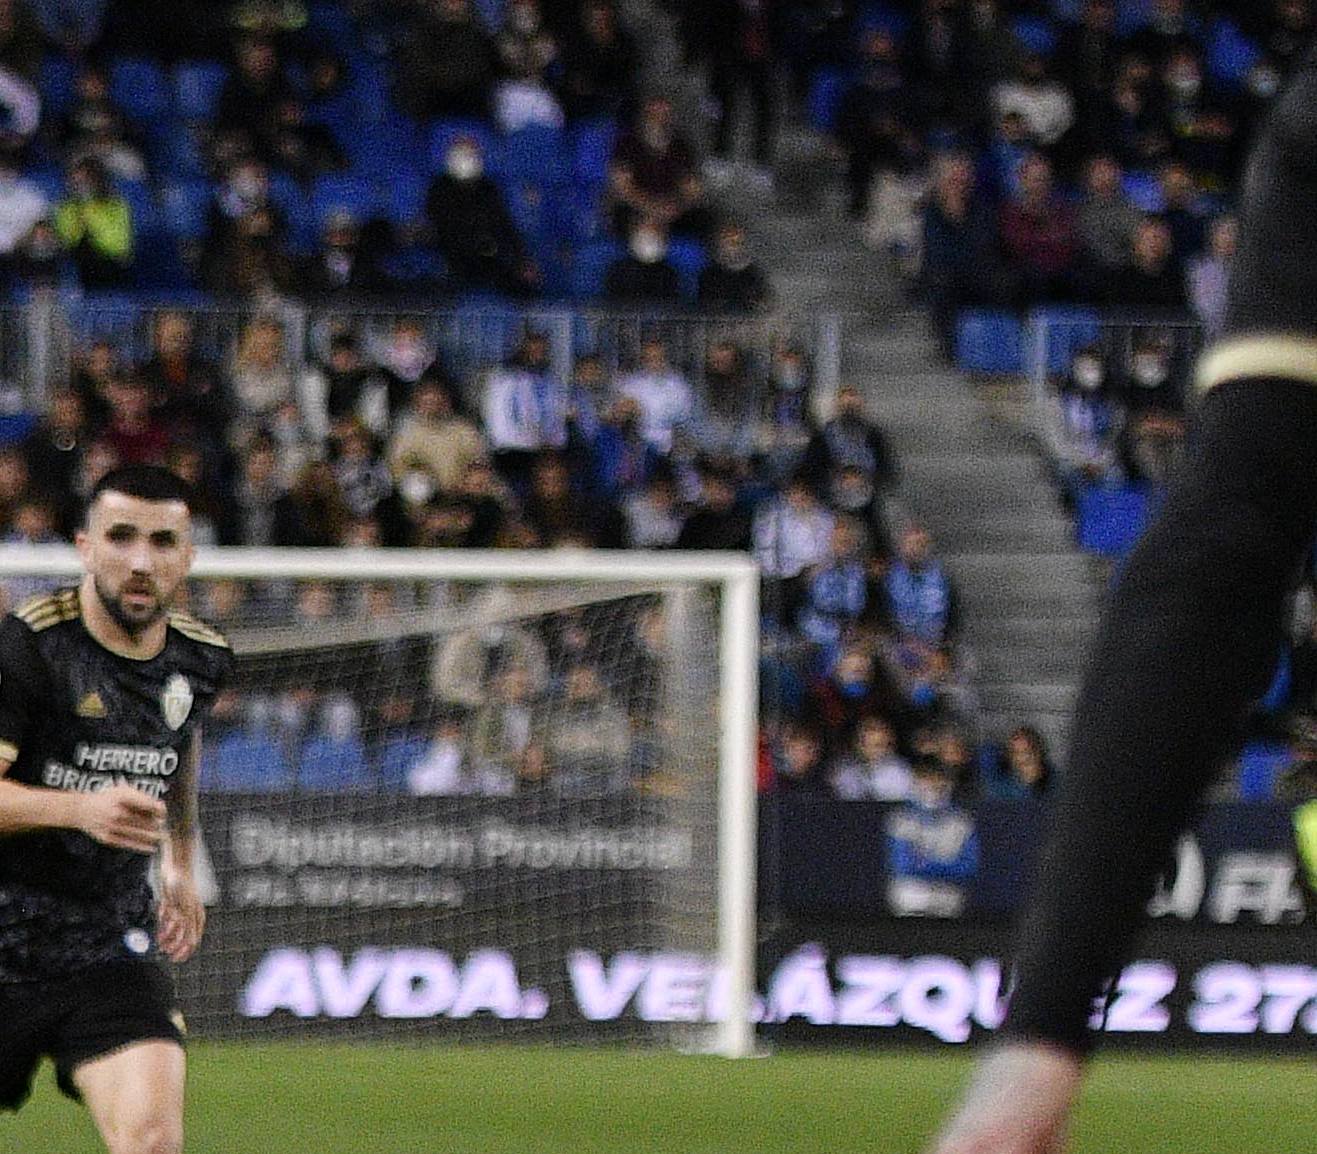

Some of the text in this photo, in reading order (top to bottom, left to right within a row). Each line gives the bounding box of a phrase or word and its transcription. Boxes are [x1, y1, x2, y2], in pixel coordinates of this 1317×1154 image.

[76, 742, 179, 775] HERRERO
[239, 944, 550, 1019] AVDA.
[1187, 958, 1317, 1034] 27
